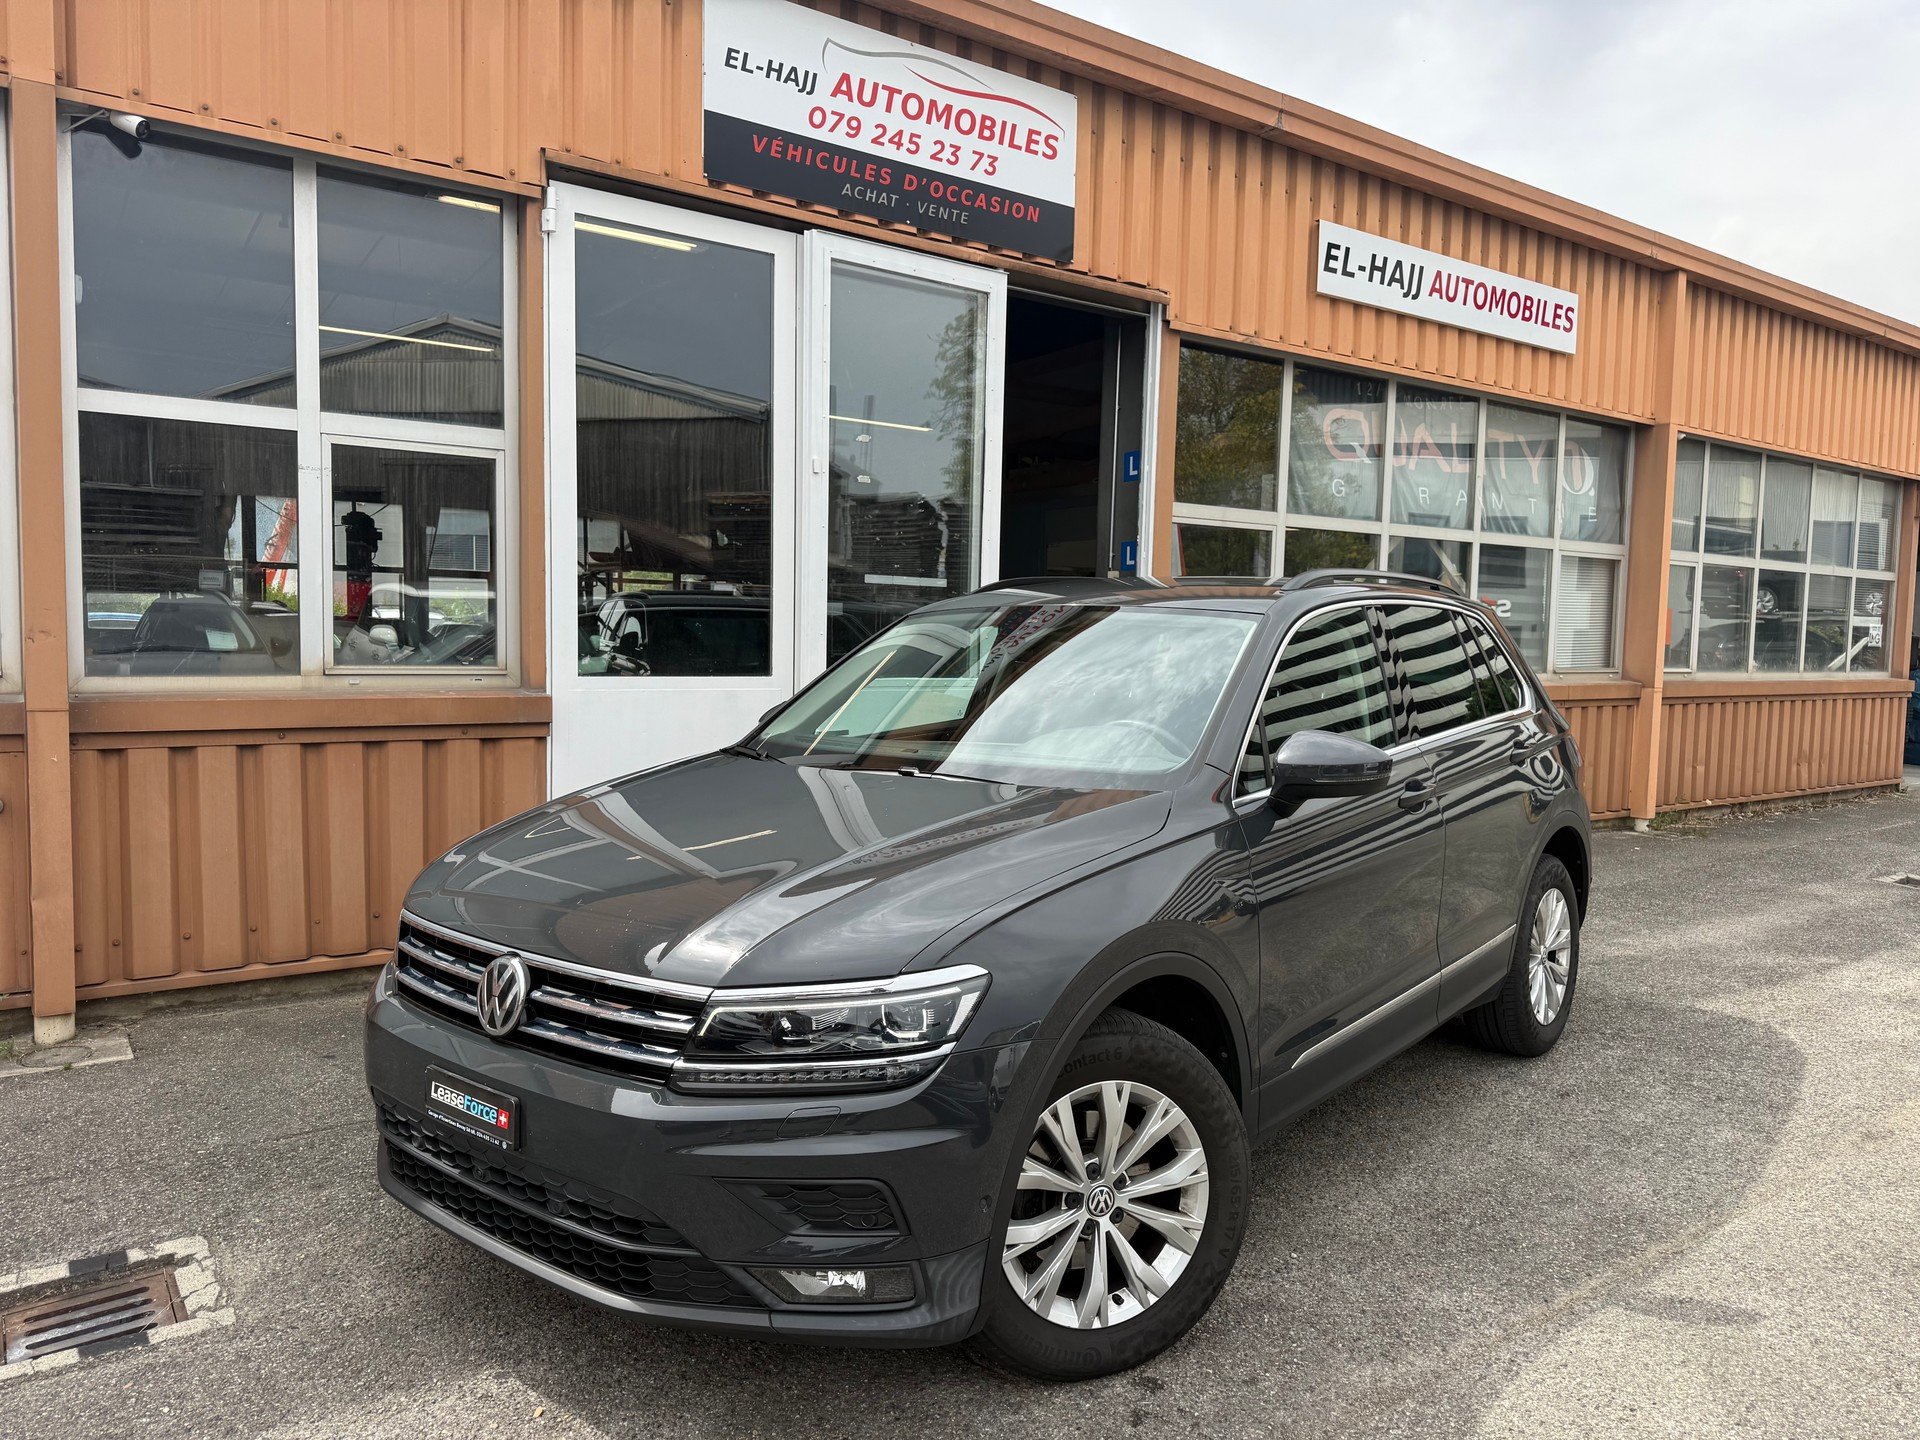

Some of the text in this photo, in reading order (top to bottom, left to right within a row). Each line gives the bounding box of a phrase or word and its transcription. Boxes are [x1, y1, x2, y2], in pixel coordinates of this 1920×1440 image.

[724, 47, 1060, 160] EL-HAJJ AUTOMOBILES
[752, 134, 892, 185] VÉHICULES
[808, 106, 999, 177] 079 245 23 73
[841, 183, 969, 225] ACHAT VENTE
[1323, 241, 1575, 333] EL-HAJJ AUTOMOBILES
[1129, 456, 1138, 476] L
[1323, 408, 1549, 485] QUALTY
[1332, 478, 1598, 523] GRANTIE
[1126, 546, 1135, 565] L
[430, 1081, 498, 1122] LeaseForce
